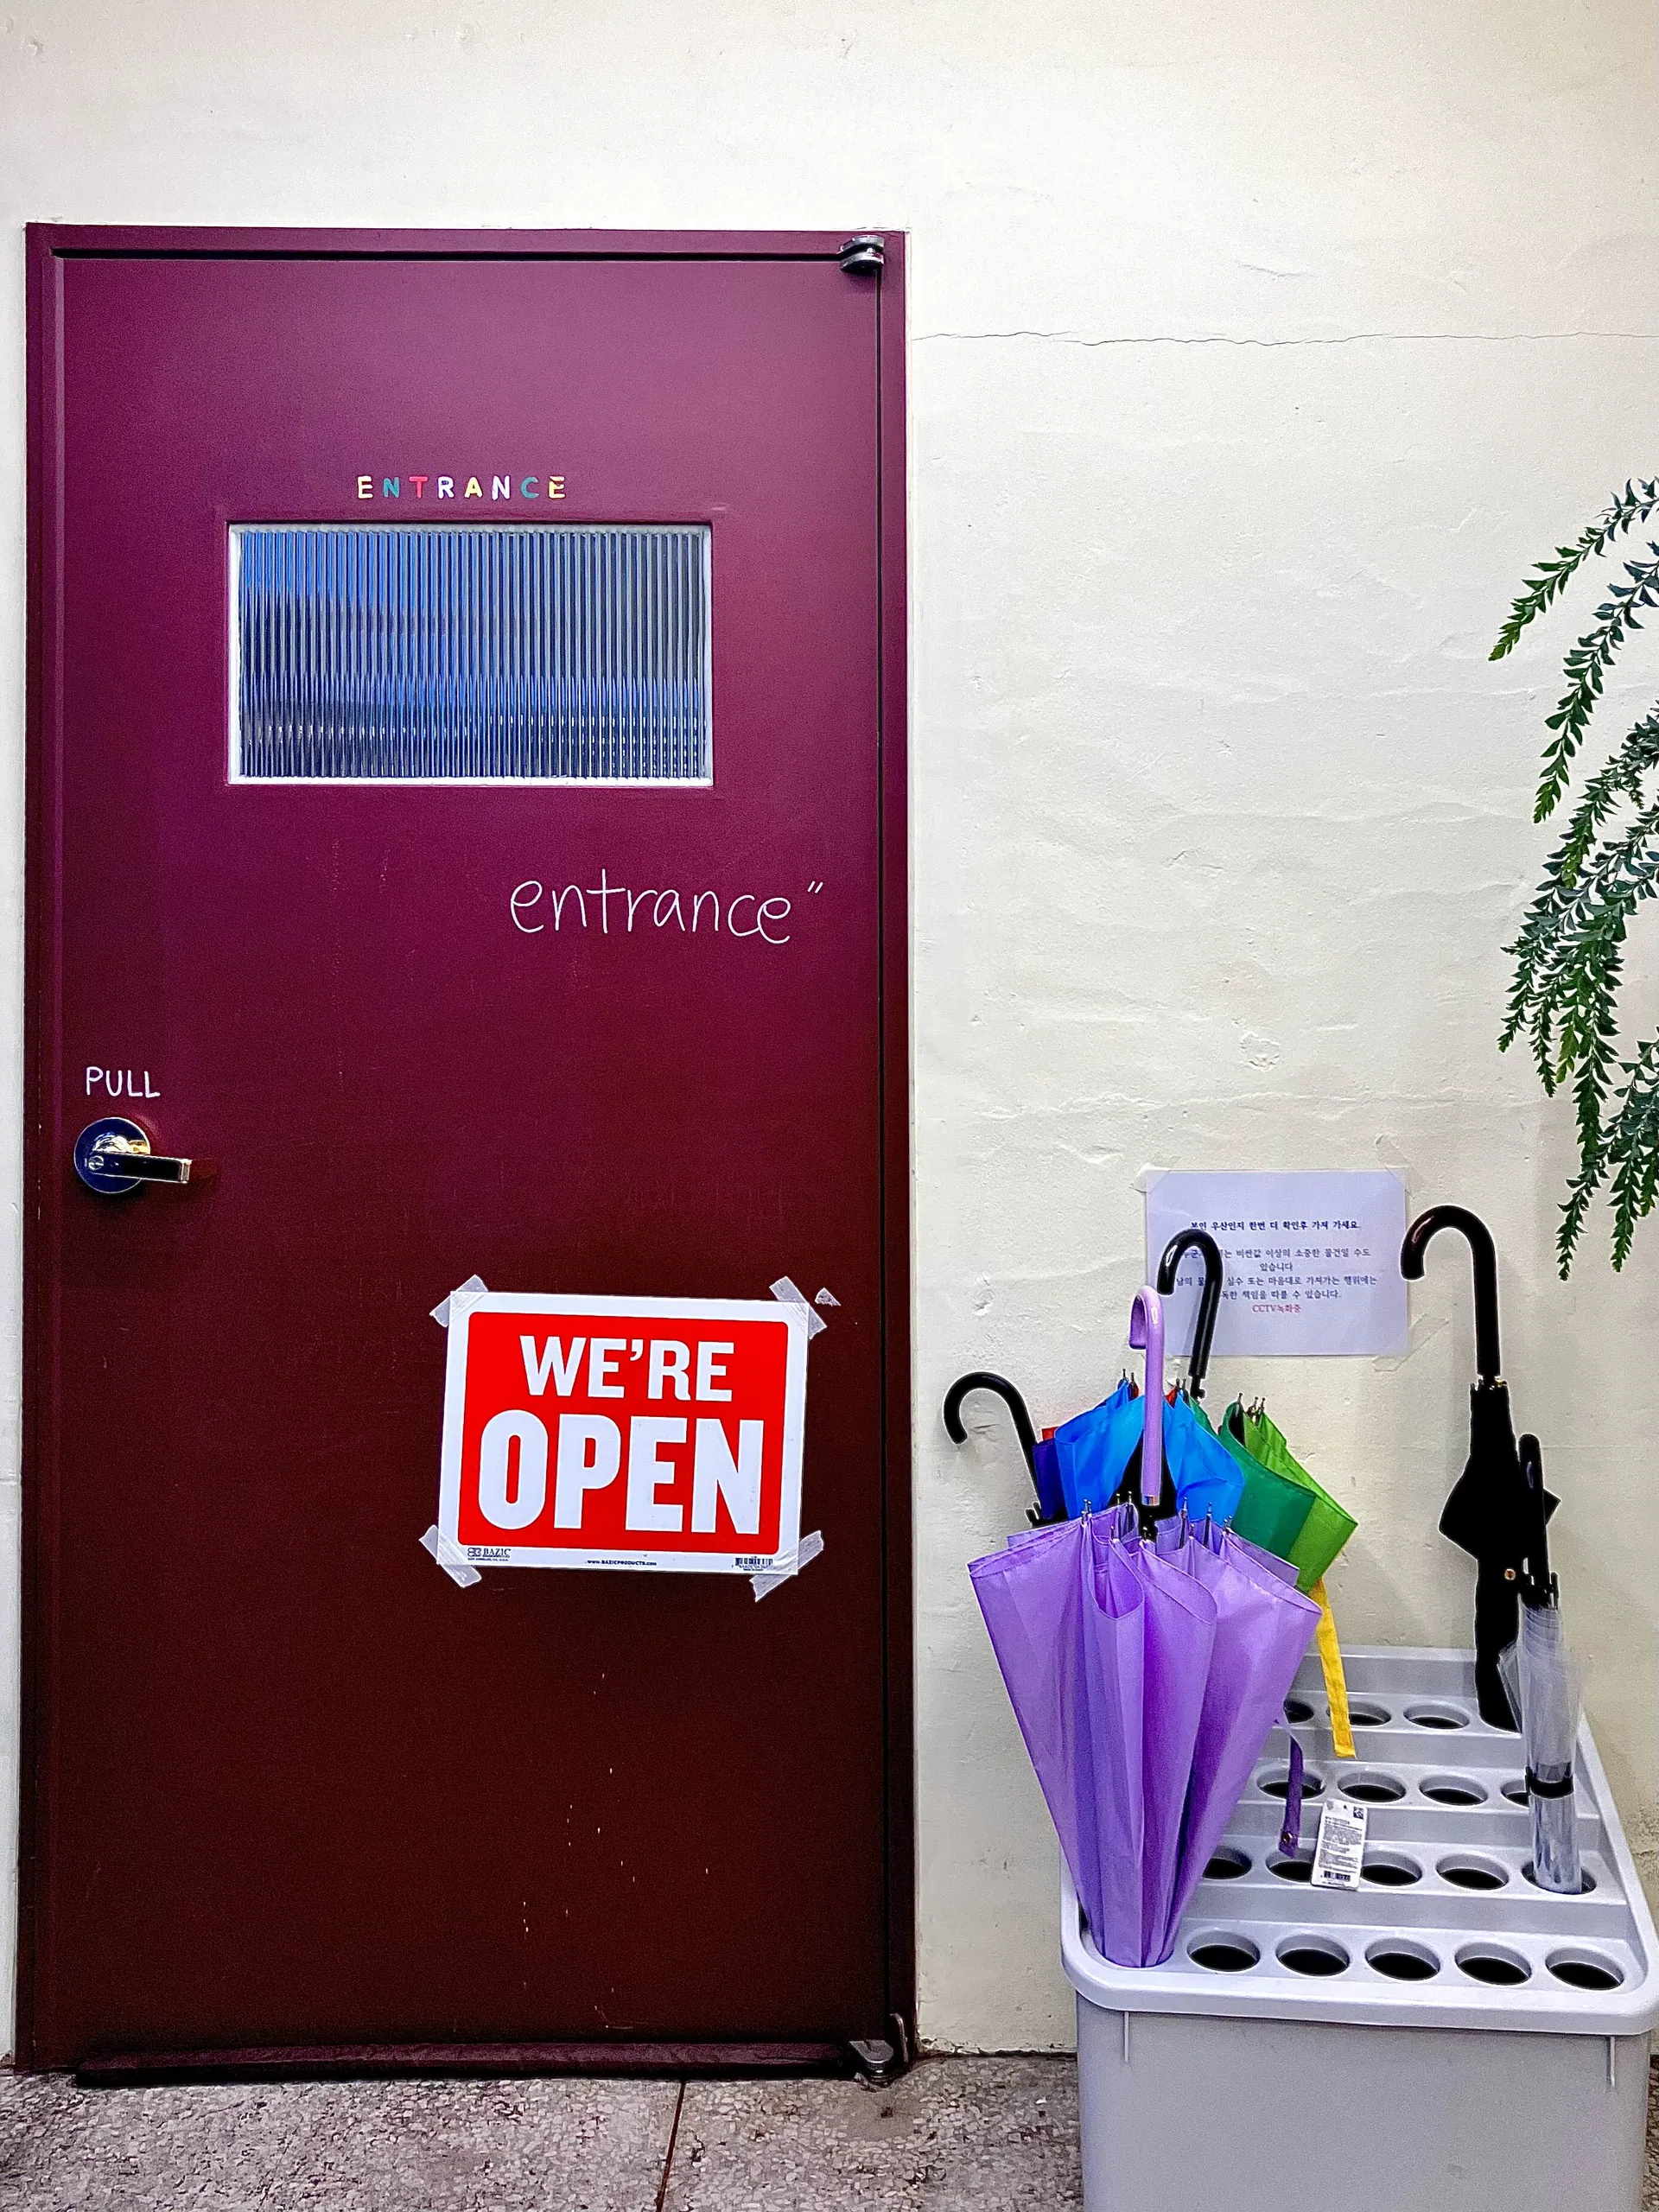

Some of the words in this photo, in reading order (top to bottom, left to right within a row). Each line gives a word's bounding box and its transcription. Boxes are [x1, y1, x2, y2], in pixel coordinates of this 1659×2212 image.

[357, 474, 566, 500] ENTRANCE
[86, 1065, 162, 1098] PULL
[1211, 1221, 1244, 1231] 우산인지
[1249, 1221, 1267, 1231] 한번
[1270, 1220, 1279, 1230] 더
[1283, 1220, 1308, 1230] 확인후
[1312, 1220, 1329, 1230] 가져
[1236, 1249, 1262, 1258] 비싼값
[1266, 1248, 1291, 1258] 이상의
[1295, 1249, 1320, 1257] 소중한
[1325, 1248, 1350, 1257] 물건일
[1354, 1249, 1372, 1257] 수도
[1260, 1262, 1293, 1272] 있습니다
[1176, 1276, 1192, 1286] 남의
[1227, 1276, 1244, 1286] 실수
[1248, 1276, 1265, 1286] 또는
[1268, 1276, 1302, 1286] 마음대로
[1306, 1275, 1340, 1285] 가져가는
[1344, 1275, 1377, 1285] 행위에는
[1243, 1290, 1267, 1300] 책임을
[1293, 1290, 1301, 1300] 수
[520, 1334, 734, 1402] WE'RE
[477, 1408, 765, 1535] OPEN
[483, 1548, 512, 1556] BAZIC
